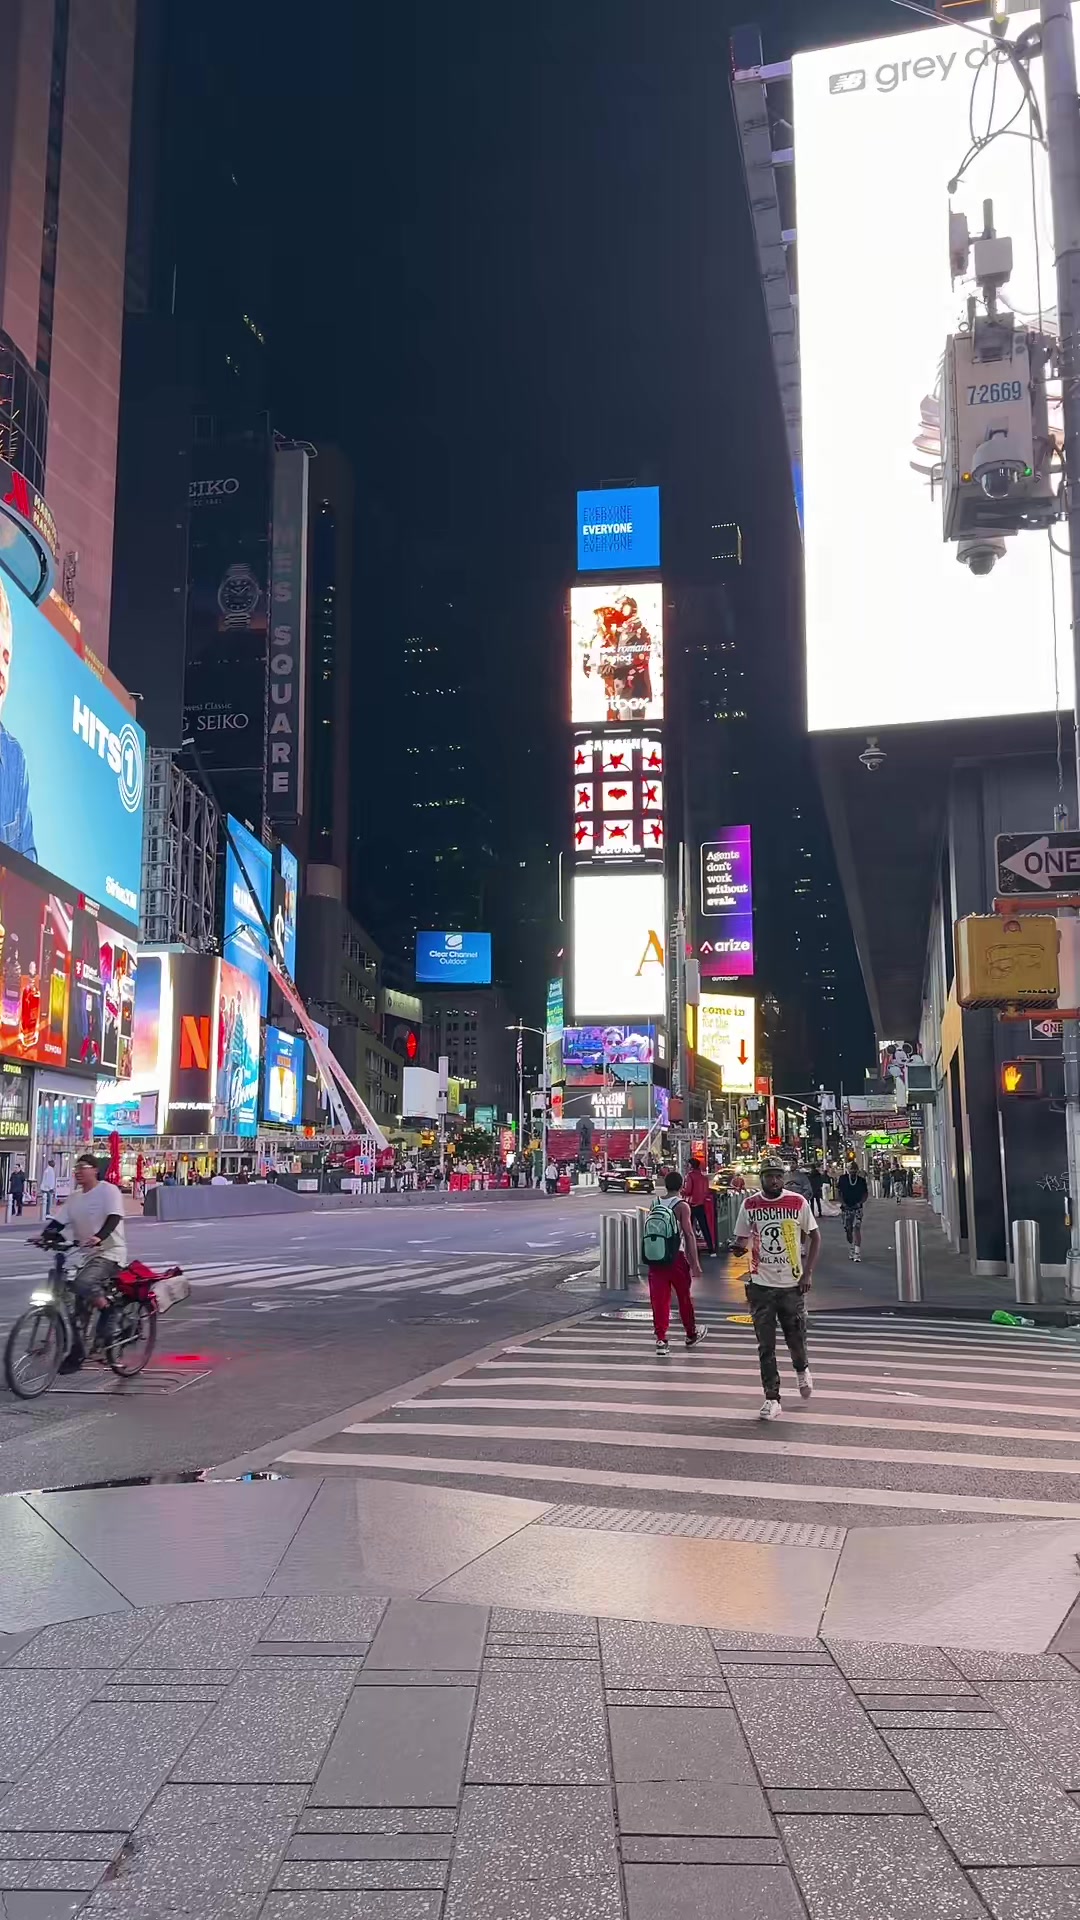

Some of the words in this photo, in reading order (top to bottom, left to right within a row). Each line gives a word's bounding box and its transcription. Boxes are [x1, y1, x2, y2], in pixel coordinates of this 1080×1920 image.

[875, 52, 957, 93] grey
[967, 380, 1023, 405] 7-2669
[189, 478, 240, 497] EIKO
[583, 522, 633, 535] EVERYONE
[271, 625, 293, 793] SQUARE
[196, 713, 249, 731] SEIKO
[72, 694, 121, 775] HITS
[125, 747, 134, 789] 1
[706, 851, 740, 861] Agents
[1024, 850, 1080, 875] ONE
[706, 862, 732, 872] don't
[706, 873, 732, 883] work
[706, 884, 749, 895] without
[714, 939, 750, 952] arize
[429, 950, 448, 958] Clear
[439, 957, 468, 965] Outdoor
[702, 1006, 732, 1016] come
[733, 1004, 745, 1017] in
[1042, 1019, 1062, 1033] ONE
[44, 1044, 62, 1055] SEPHORA
[3, 1063, 22, 1075] SEPHORA
[591, 1092, 625, 1105] AARON
[0, 1121, 29, 1136] EPHORA
[748, 1207, 799, 1222] MOSCHINO
